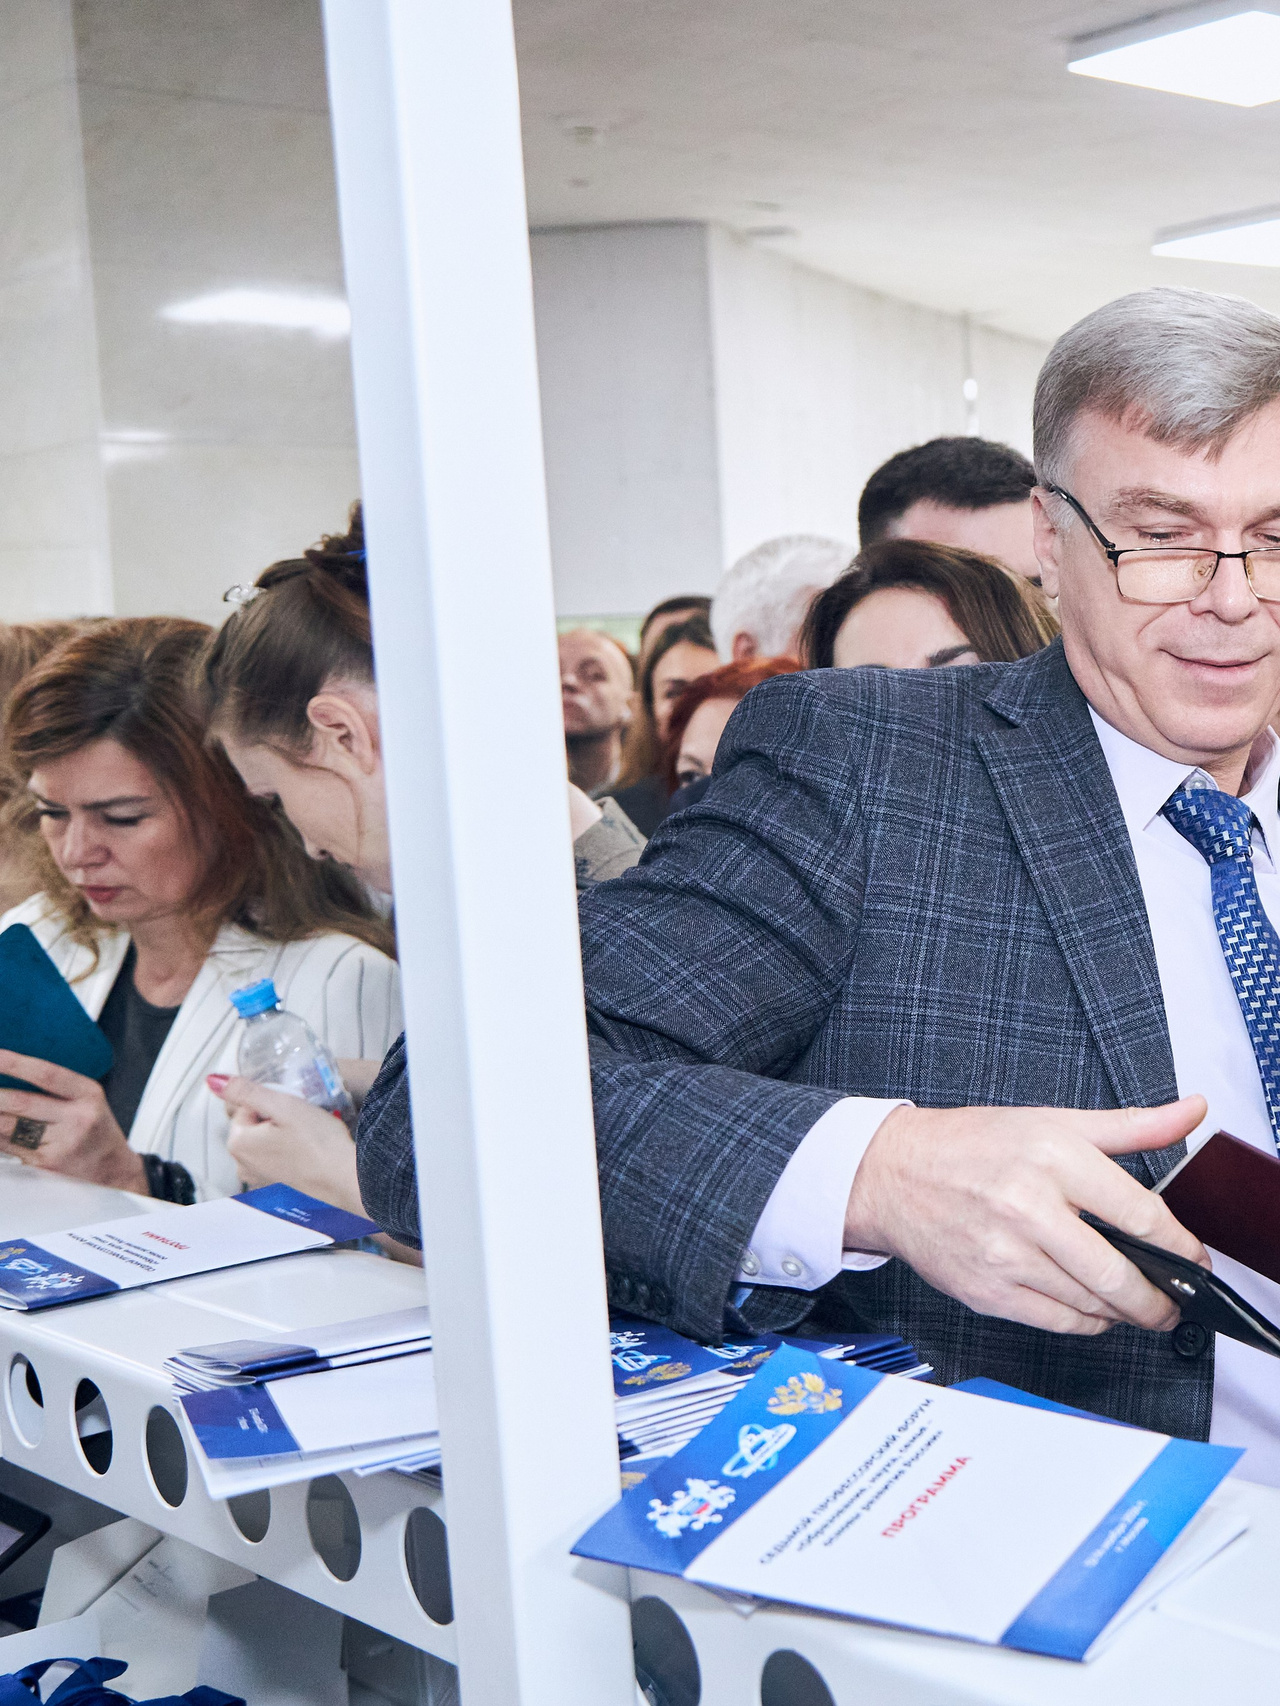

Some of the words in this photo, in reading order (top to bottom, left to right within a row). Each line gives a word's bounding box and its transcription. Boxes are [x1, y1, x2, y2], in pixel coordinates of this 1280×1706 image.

[759, 1517, 815, 1564] СЕДЬМОЙ
[812, 1434, 900, 1515] ПРОФЕССОРСКИЙ
[897, 1398, 935, 1432] ФОРУМ
[881, 1457, 974, 1538] ПРОГРАММА
